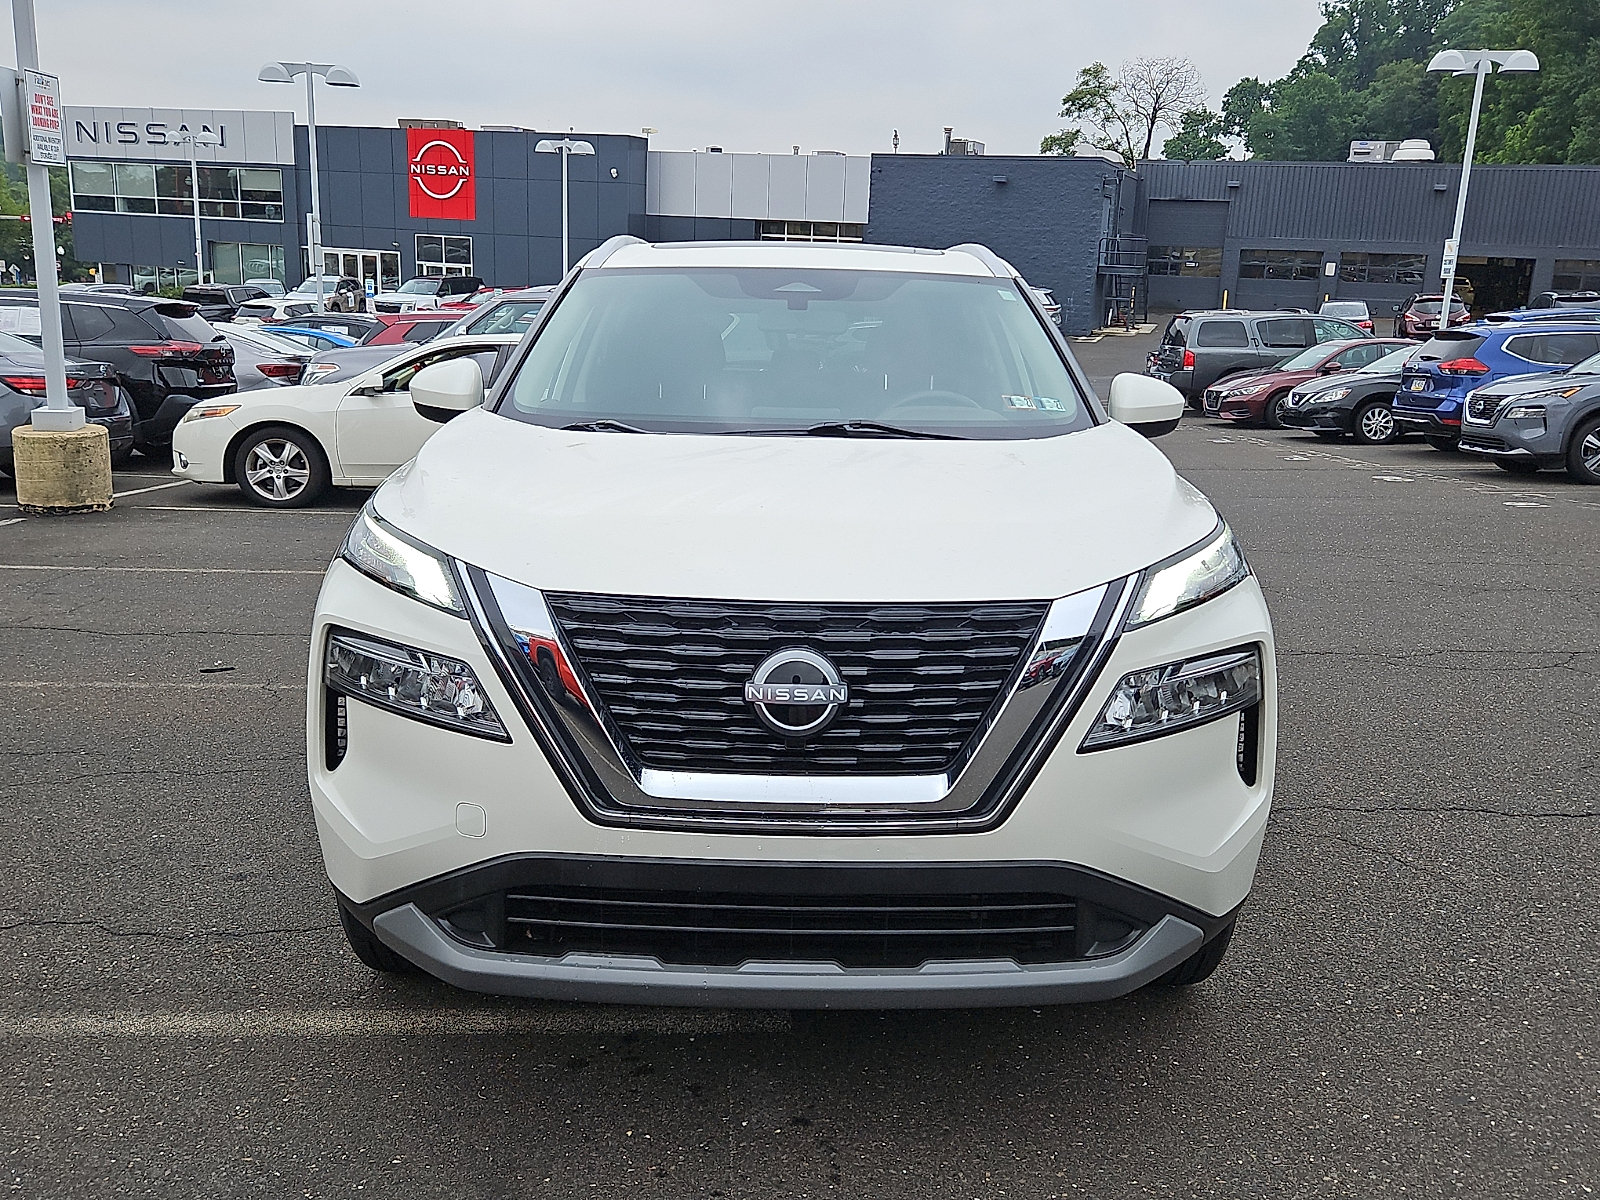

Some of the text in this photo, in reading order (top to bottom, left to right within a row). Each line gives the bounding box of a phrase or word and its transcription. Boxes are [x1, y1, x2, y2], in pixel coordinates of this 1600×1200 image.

[32, 104, 42, 115] WHAT
[43, 107, 51, 117] YOU
[410, 163, 470, 176] NISSAN
[748, 686, 845, 701] NISSAN
